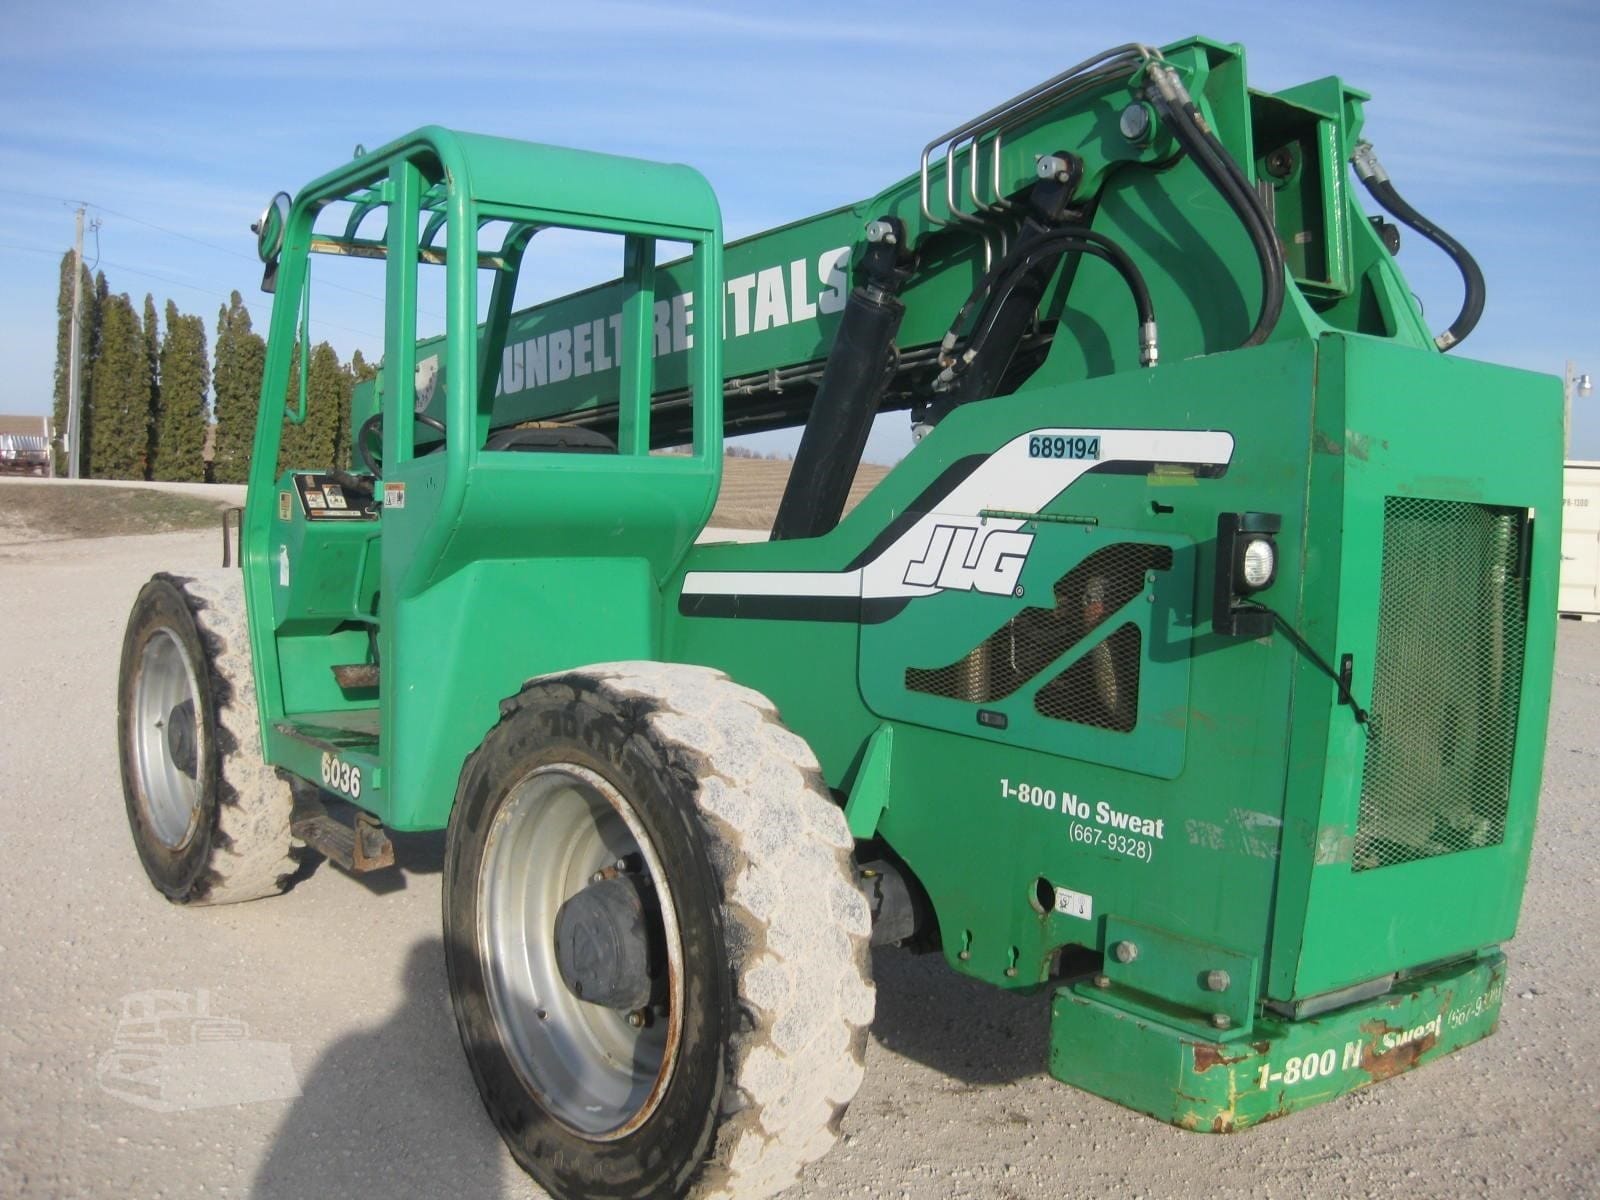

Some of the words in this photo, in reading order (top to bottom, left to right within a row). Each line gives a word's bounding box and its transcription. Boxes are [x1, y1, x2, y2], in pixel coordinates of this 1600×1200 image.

[495, 311, 625, 398] UNBELT
[653, 246, 851, 358] RETALS
[1029, 437, 1099, 460] 689194
[902, 525, 1036, 597] JLG
[321, 751, 361, 800] 6036
[1000, 779, 1056, 810] 1-800
[1061, 792, 1090, 819] No
[1096, 801, 1164, 839] Sweat
[1069, 820, 1152, 863] (667-9328)
[1258, 1048, 1336, 1089] 1-800
